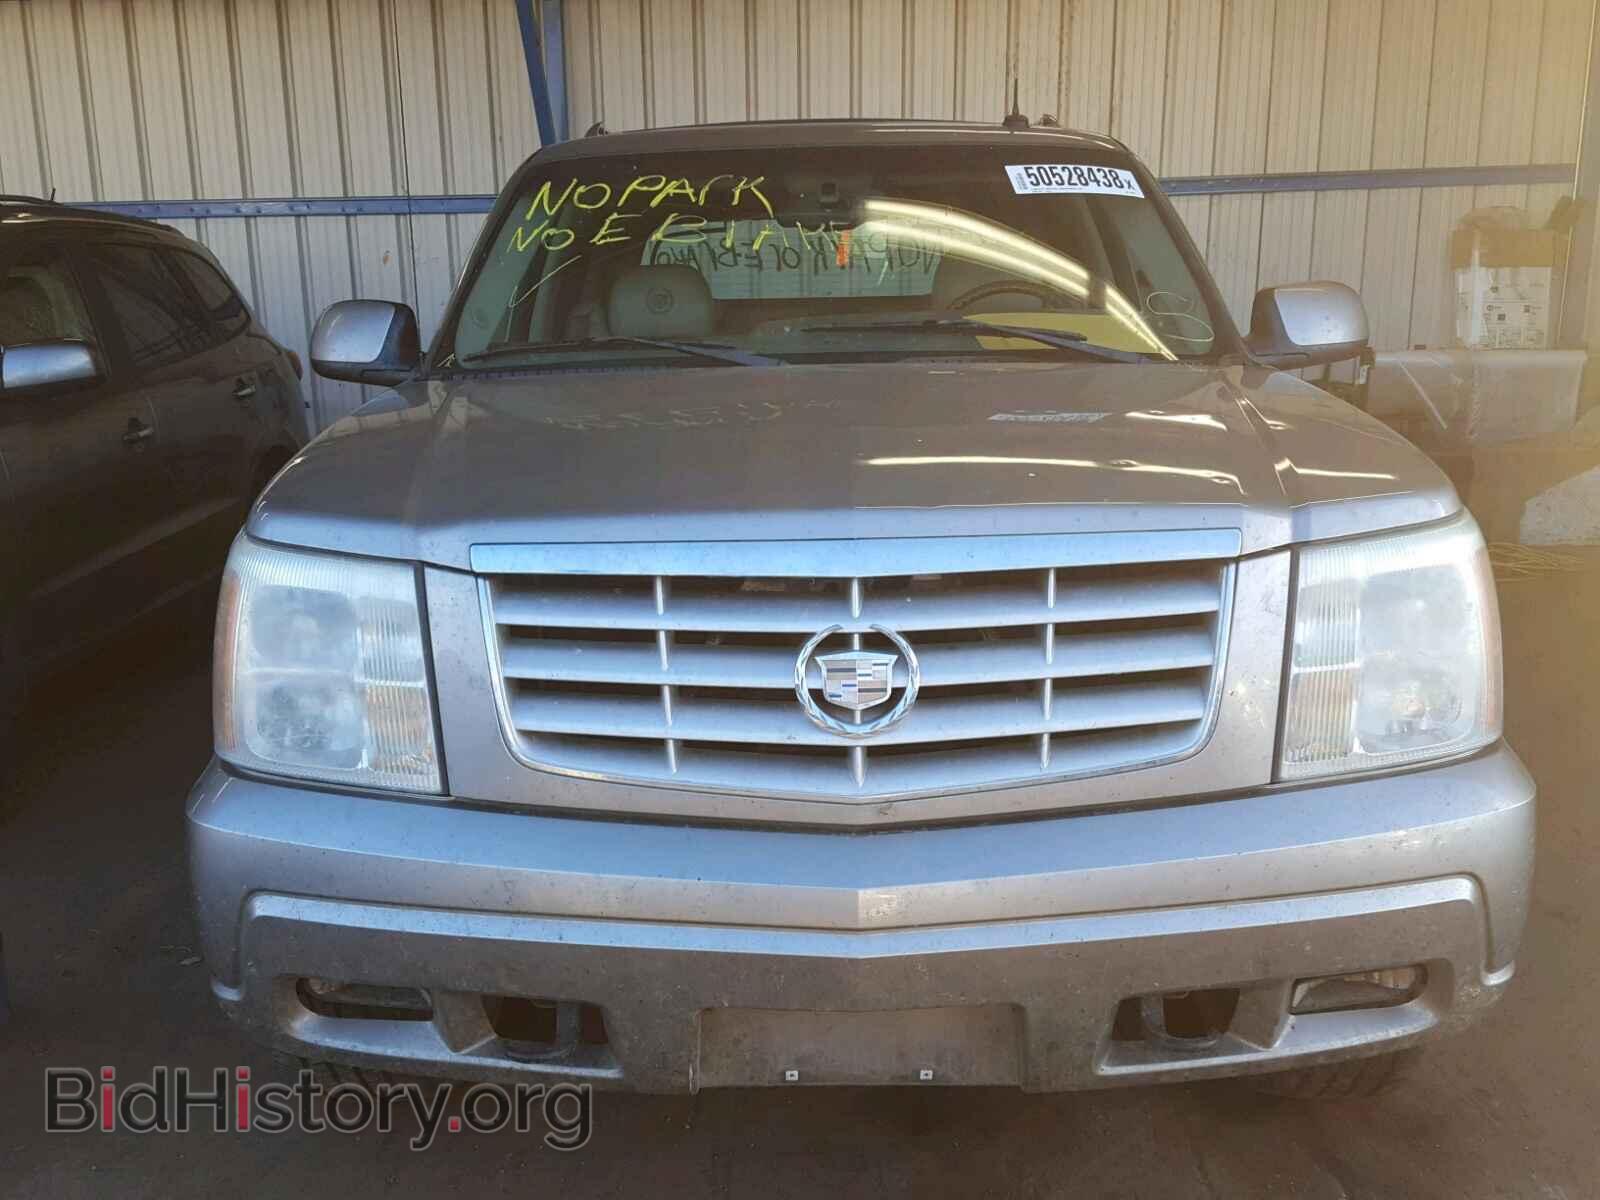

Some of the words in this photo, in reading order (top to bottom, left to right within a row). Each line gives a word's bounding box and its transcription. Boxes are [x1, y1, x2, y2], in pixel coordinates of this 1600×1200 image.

[1023, 166, 1124, 189] 50528438
[525, 177, 612, 220] NO
[507, 219, 576, 252] NO
